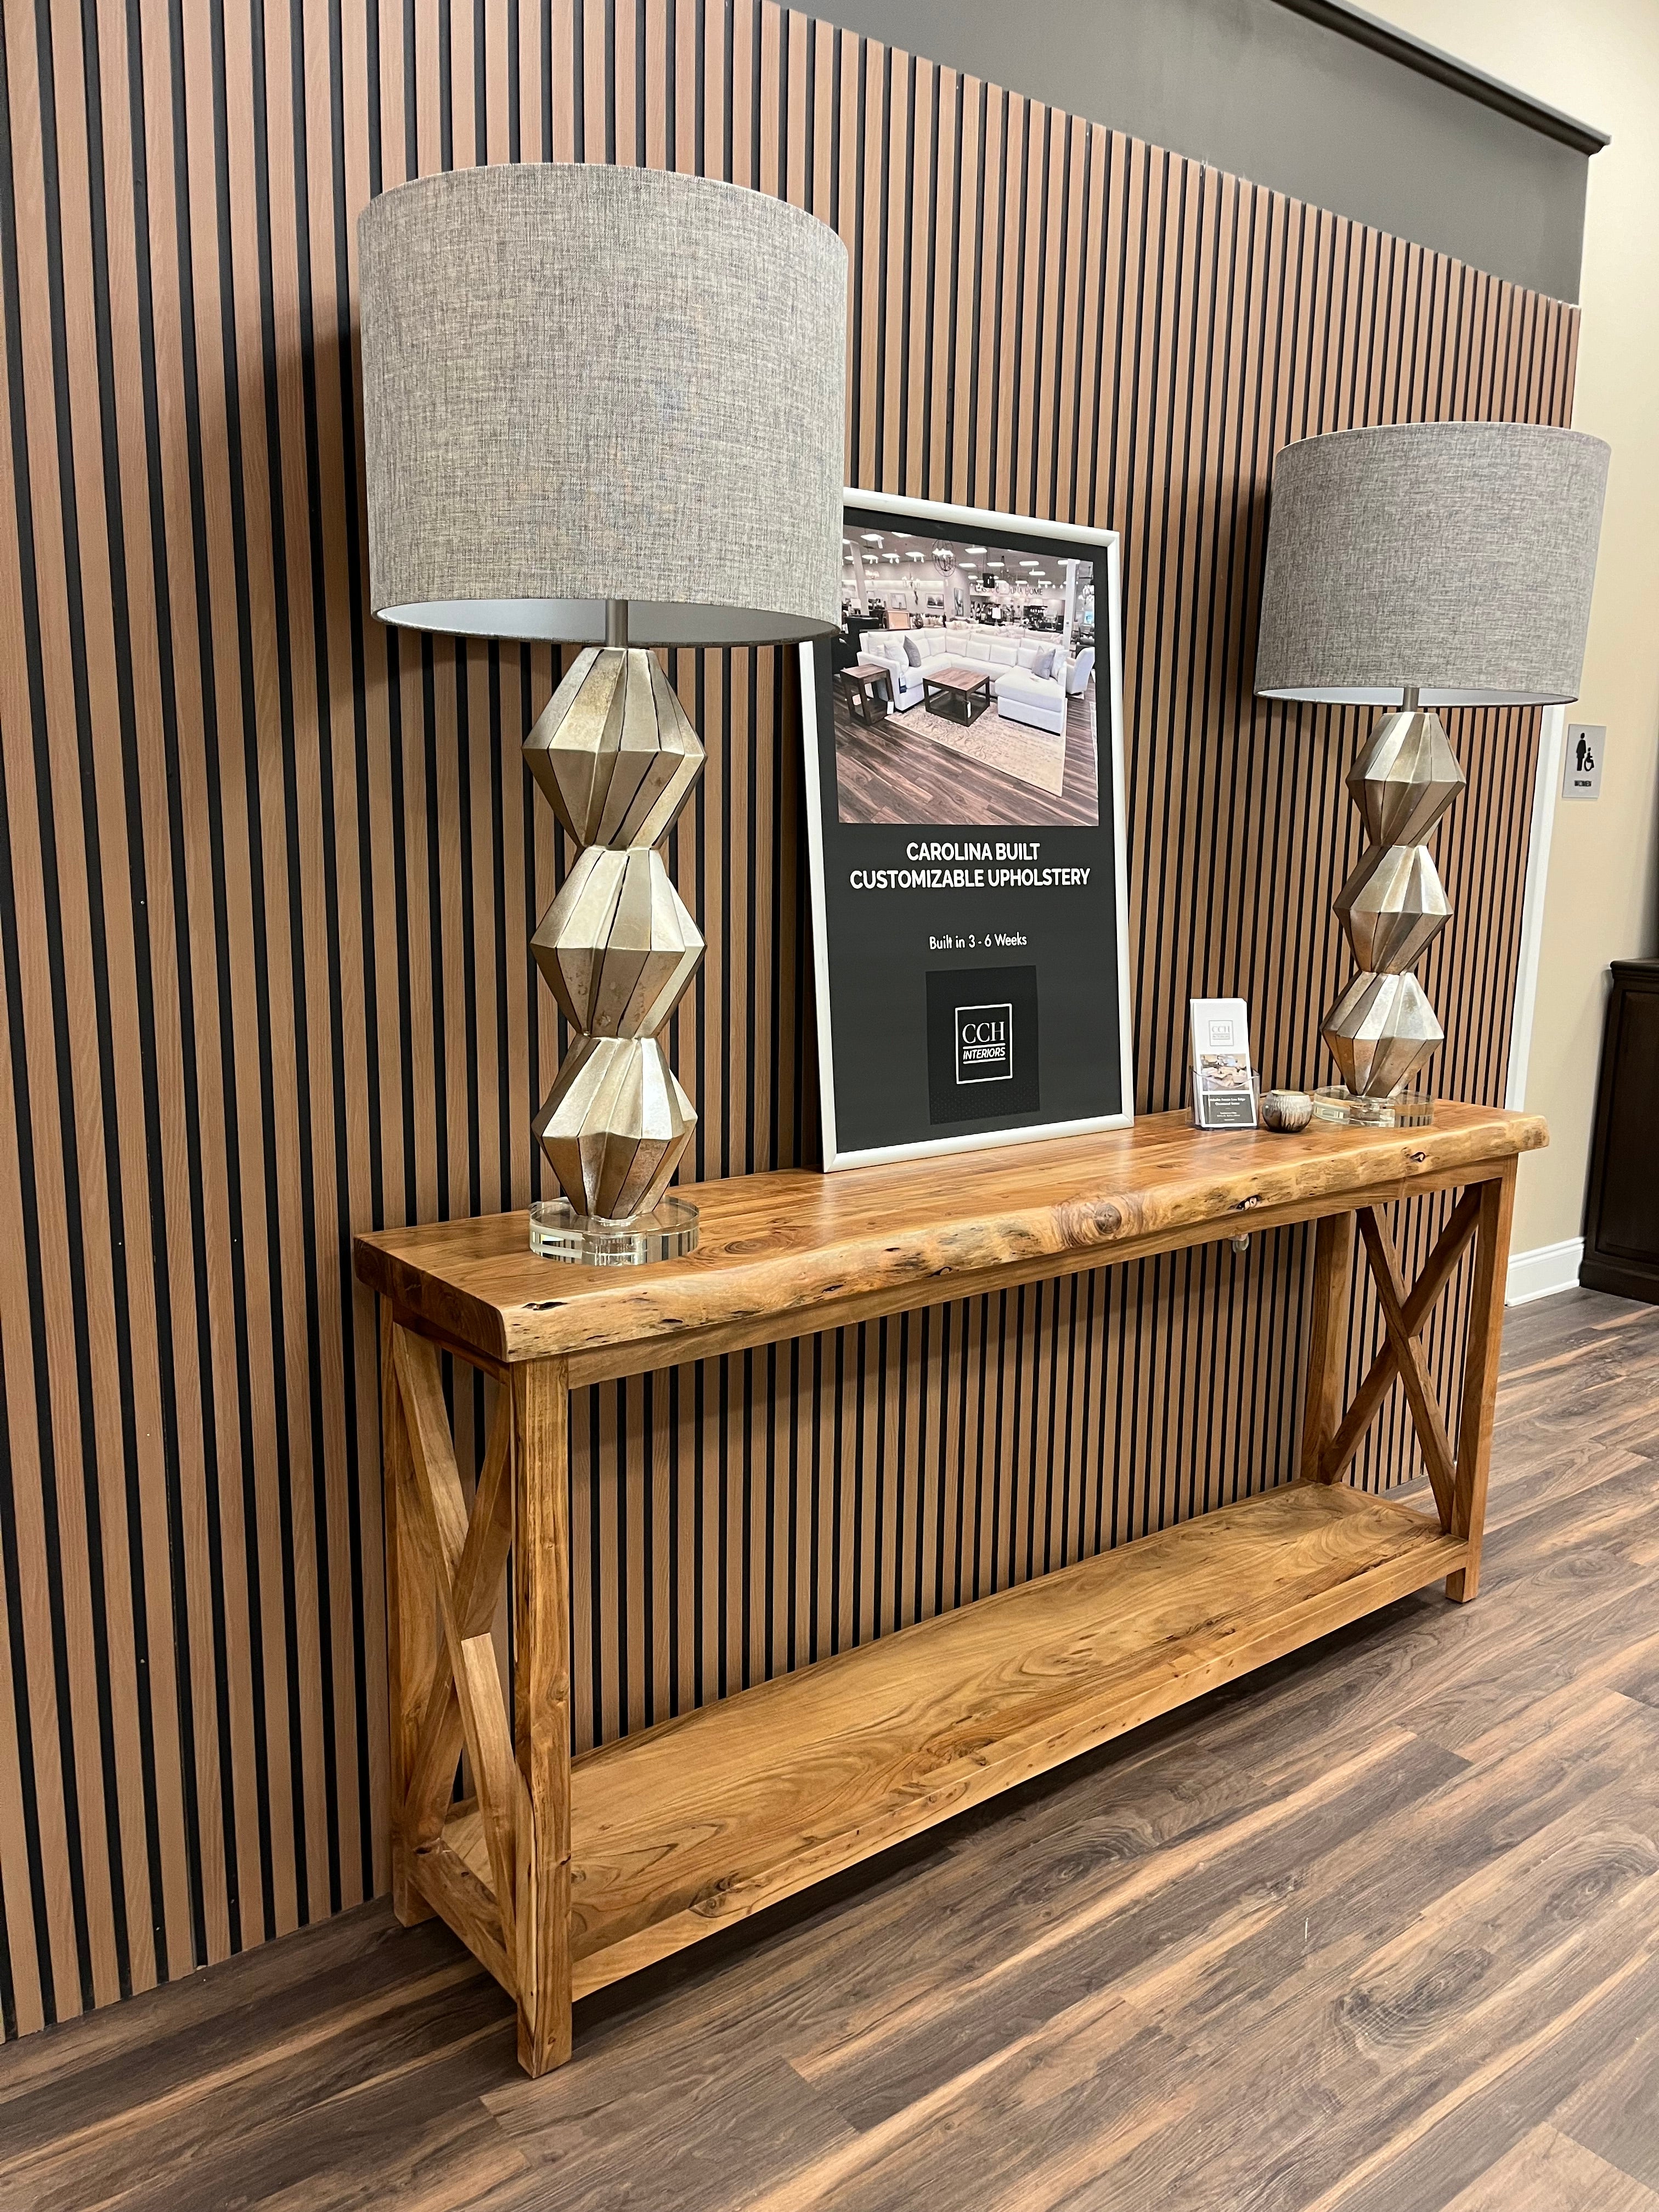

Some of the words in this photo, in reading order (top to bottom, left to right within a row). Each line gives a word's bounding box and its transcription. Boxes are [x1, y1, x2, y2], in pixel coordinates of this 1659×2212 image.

[906, 842, 992, 861] CAROLINA
[996, 843, 1041, 861] BUILT
[850, 870, 985, 889] CUSTOMIZABLE
[988, 868, 1091, 887] UPHOLSTERY
[929, 934, 952, 950] Built
[955, 935, 966, 949] in
[968, 934, 975, 948] 3
[984, 934, 992, 947] 6
[994, 931, 1027, 946] Weeks
[962, 1021, 1005, 1044] CCH
[963, 1047, 1006, 1060] INTERIORS
